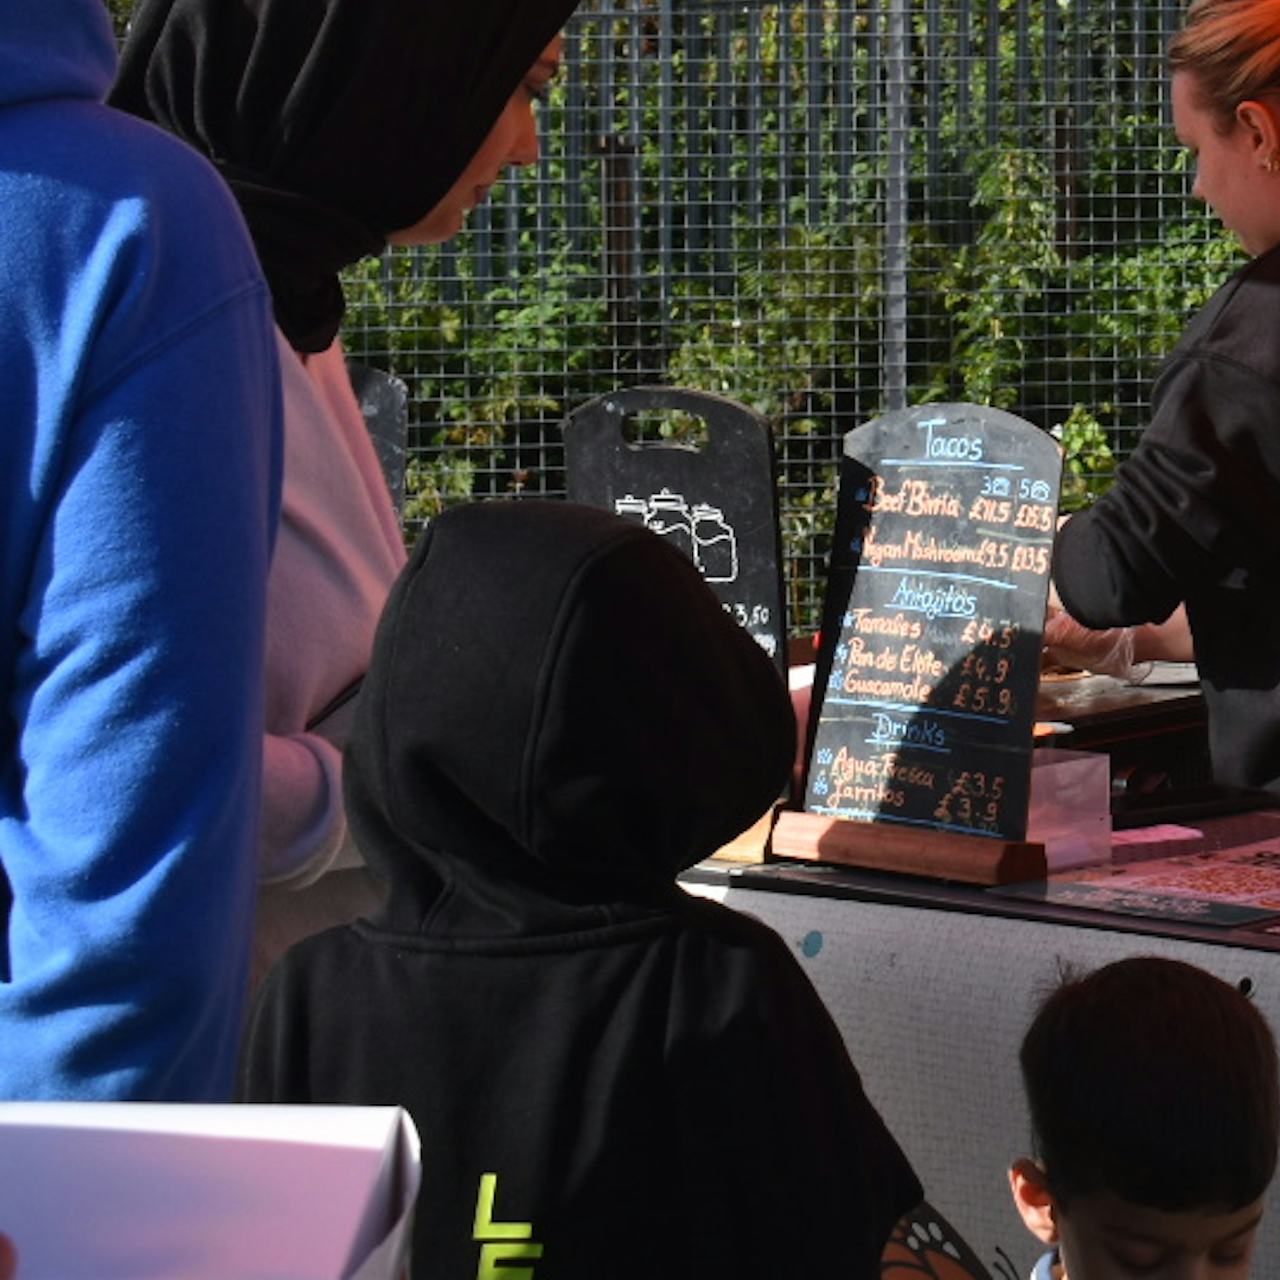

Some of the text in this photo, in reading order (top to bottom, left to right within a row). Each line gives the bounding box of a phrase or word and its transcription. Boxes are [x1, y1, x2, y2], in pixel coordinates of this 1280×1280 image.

[916, 419, 983, 461] Tacos
[864, 476, 909, 512] Beef
[862, 526, 903, 567] Vegan
[852, 608, 921, 638] Tamales
[849, 637, 874, 666] Pan
[876, 646, 898, 671] de
[872, 713, 946, 746] Drinks
[826, 775, 905, 808] Jarritos
